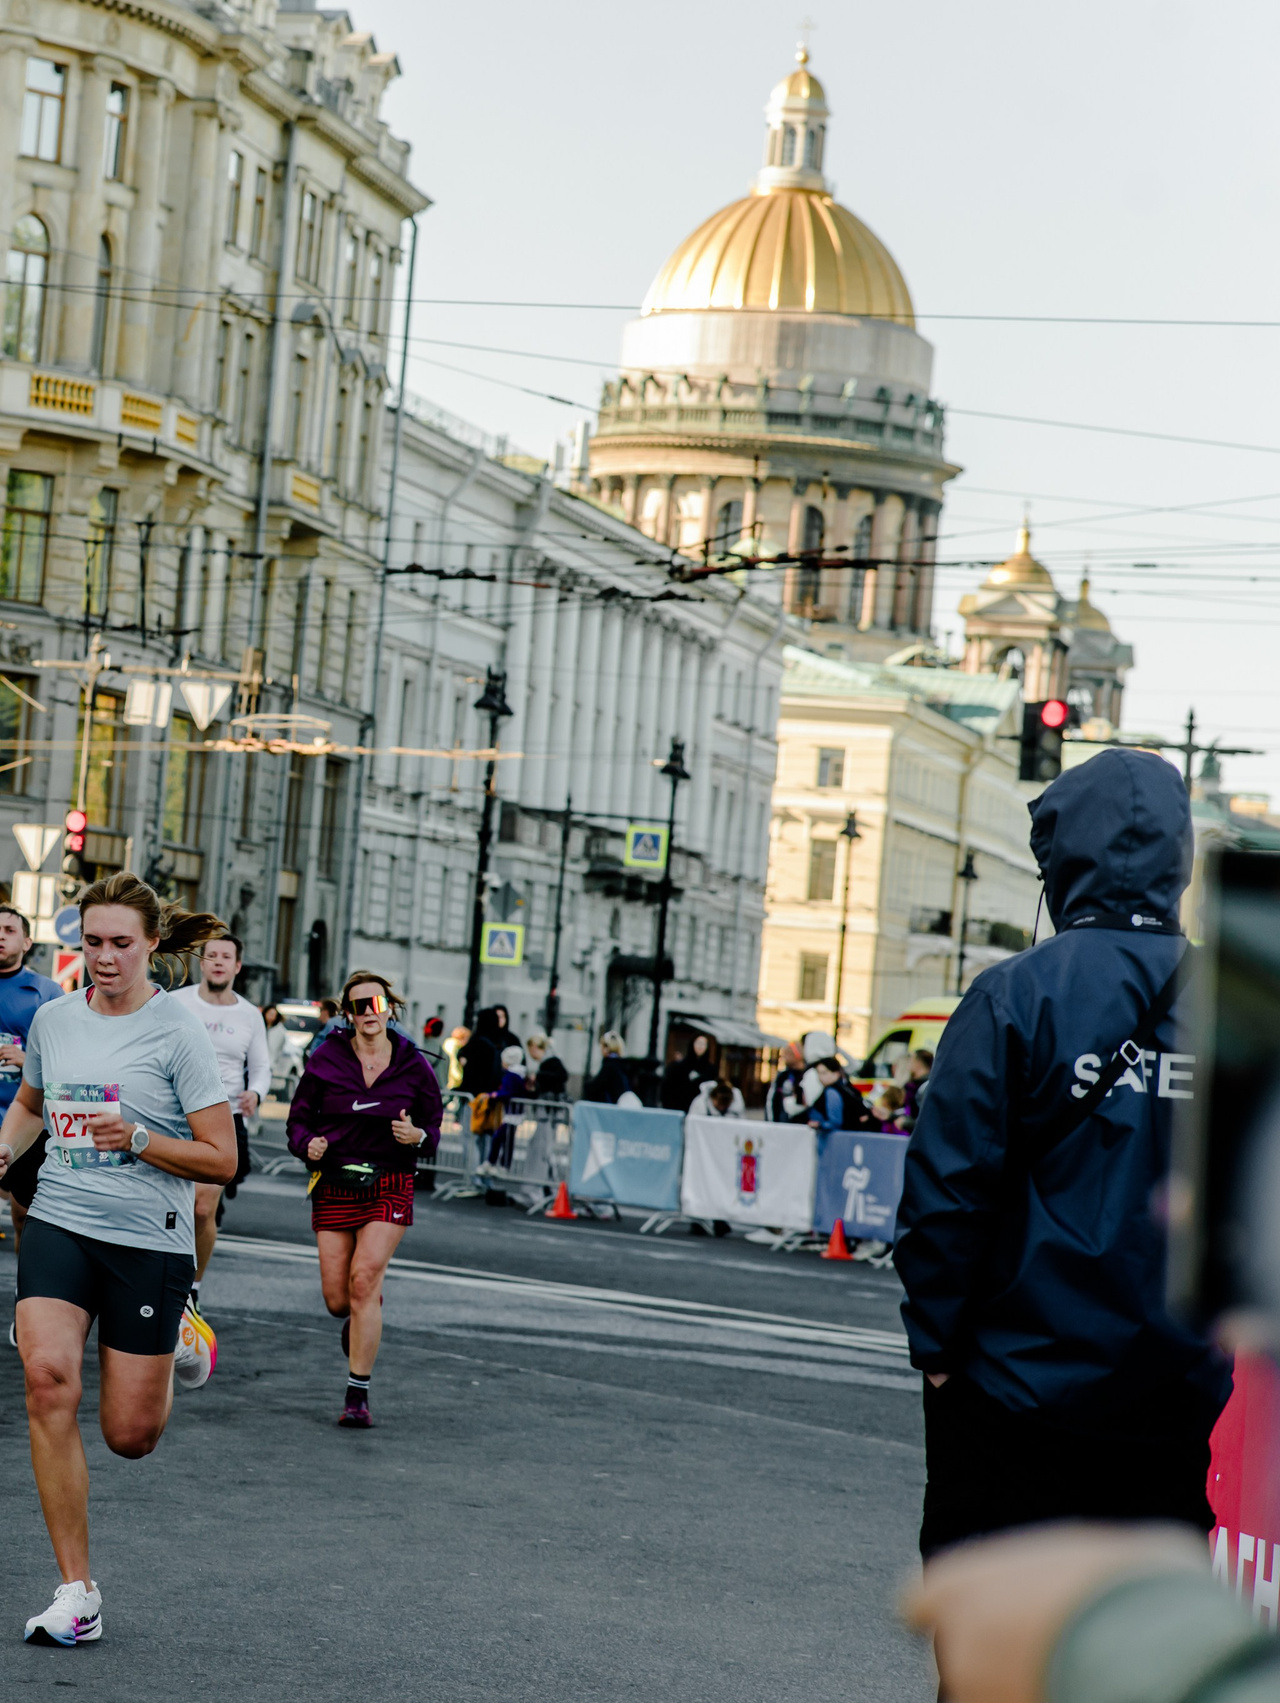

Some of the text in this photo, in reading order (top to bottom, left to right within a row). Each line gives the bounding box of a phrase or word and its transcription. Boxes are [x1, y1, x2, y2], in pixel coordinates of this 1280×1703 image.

[1071, 1048, 1197, 1099] SAFE
[79, 1089, 88, 1097] 10
[51, 1111, 98, 1138] 127
